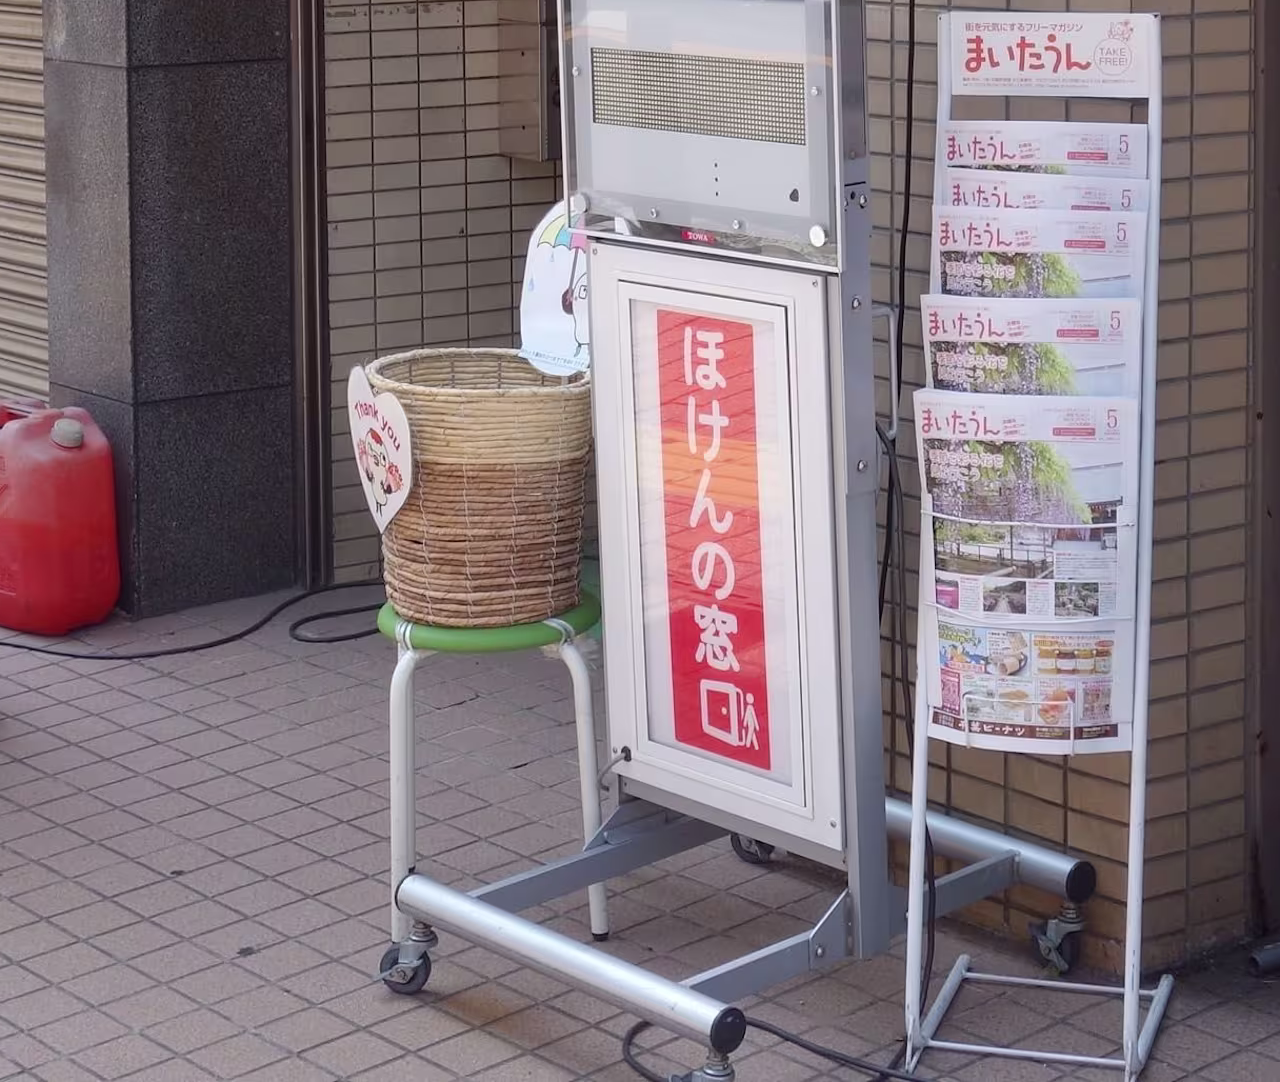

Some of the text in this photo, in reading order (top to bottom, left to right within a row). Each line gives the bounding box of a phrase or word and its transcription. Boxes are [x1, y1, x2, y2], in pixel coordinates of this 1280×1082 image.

[964, 22, 1083, 33] 街を元気にするフリーマガジン
[964, 33, 1092, 74] まいたうん
[1098, 47, 1126, 57] TAKE
[1098, 57, 1128, 67] FREE!
[946, 135, 1016, 161] まいたうん
[1119, 134, 1130, 155] 5
[952, 183, 1020, 208] まいたうん
[1120, 189, 1132, 209] 5
[687, 231, 709, 242] TOWA
[939, 221, 1013, 249] まいたうん
[1116, 222, 1127, 242] 5
[928, 311, 1005, 339] まいたうん
[1110, 310, 1121, 331] 5
[354, 400, 401, 452] Thank you
[921, 408, 1001, 437] まいたうん
[1106, 409, 1118, 429] 5
[683, 326, 742, 747] ほけんの窓口
